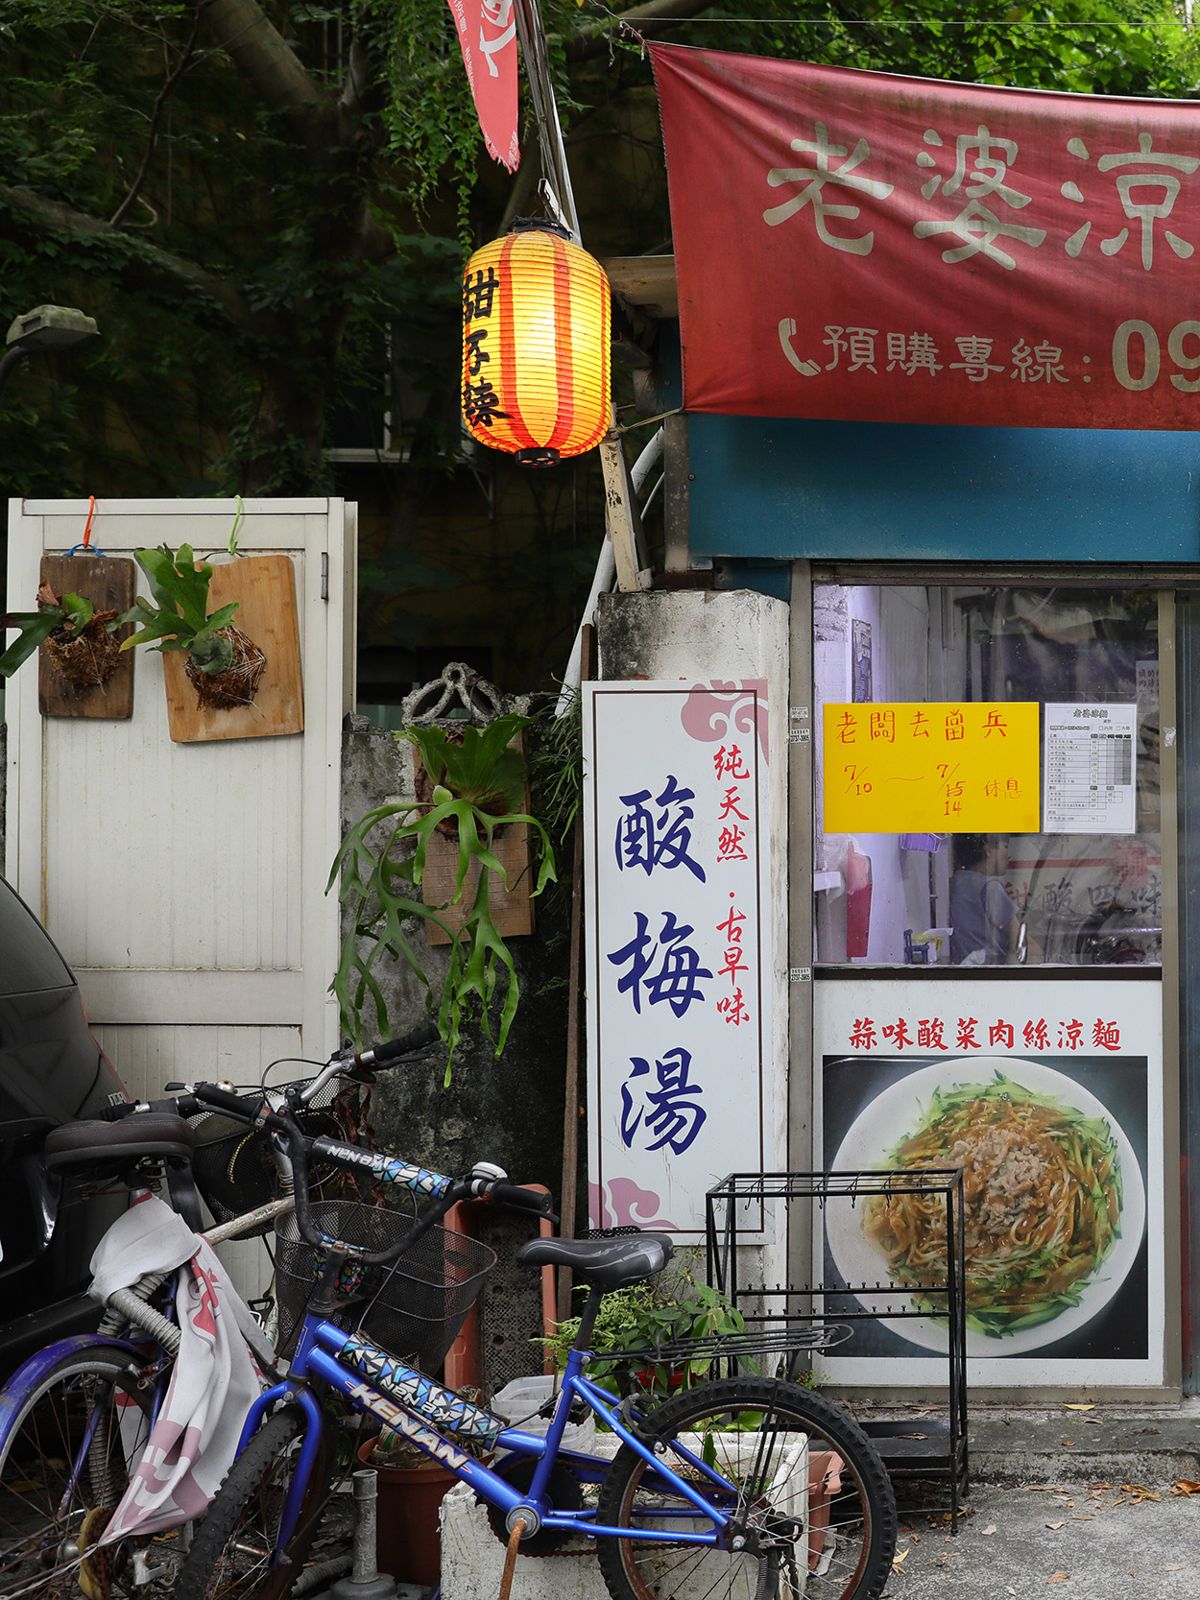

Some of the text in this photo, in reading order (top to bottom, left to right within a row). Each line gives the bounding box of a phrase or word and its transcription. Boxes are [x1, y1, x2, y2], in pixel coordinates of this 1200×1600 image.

[834, 708, 1007, 743] 老闆去當兵
[606, 774, 714, 1156] 酸梅湯
[848, 1016, 1122, 1051] 蒜味酸菜肉絲涼麵
[349, 1382, 471, 1469] KENAN
